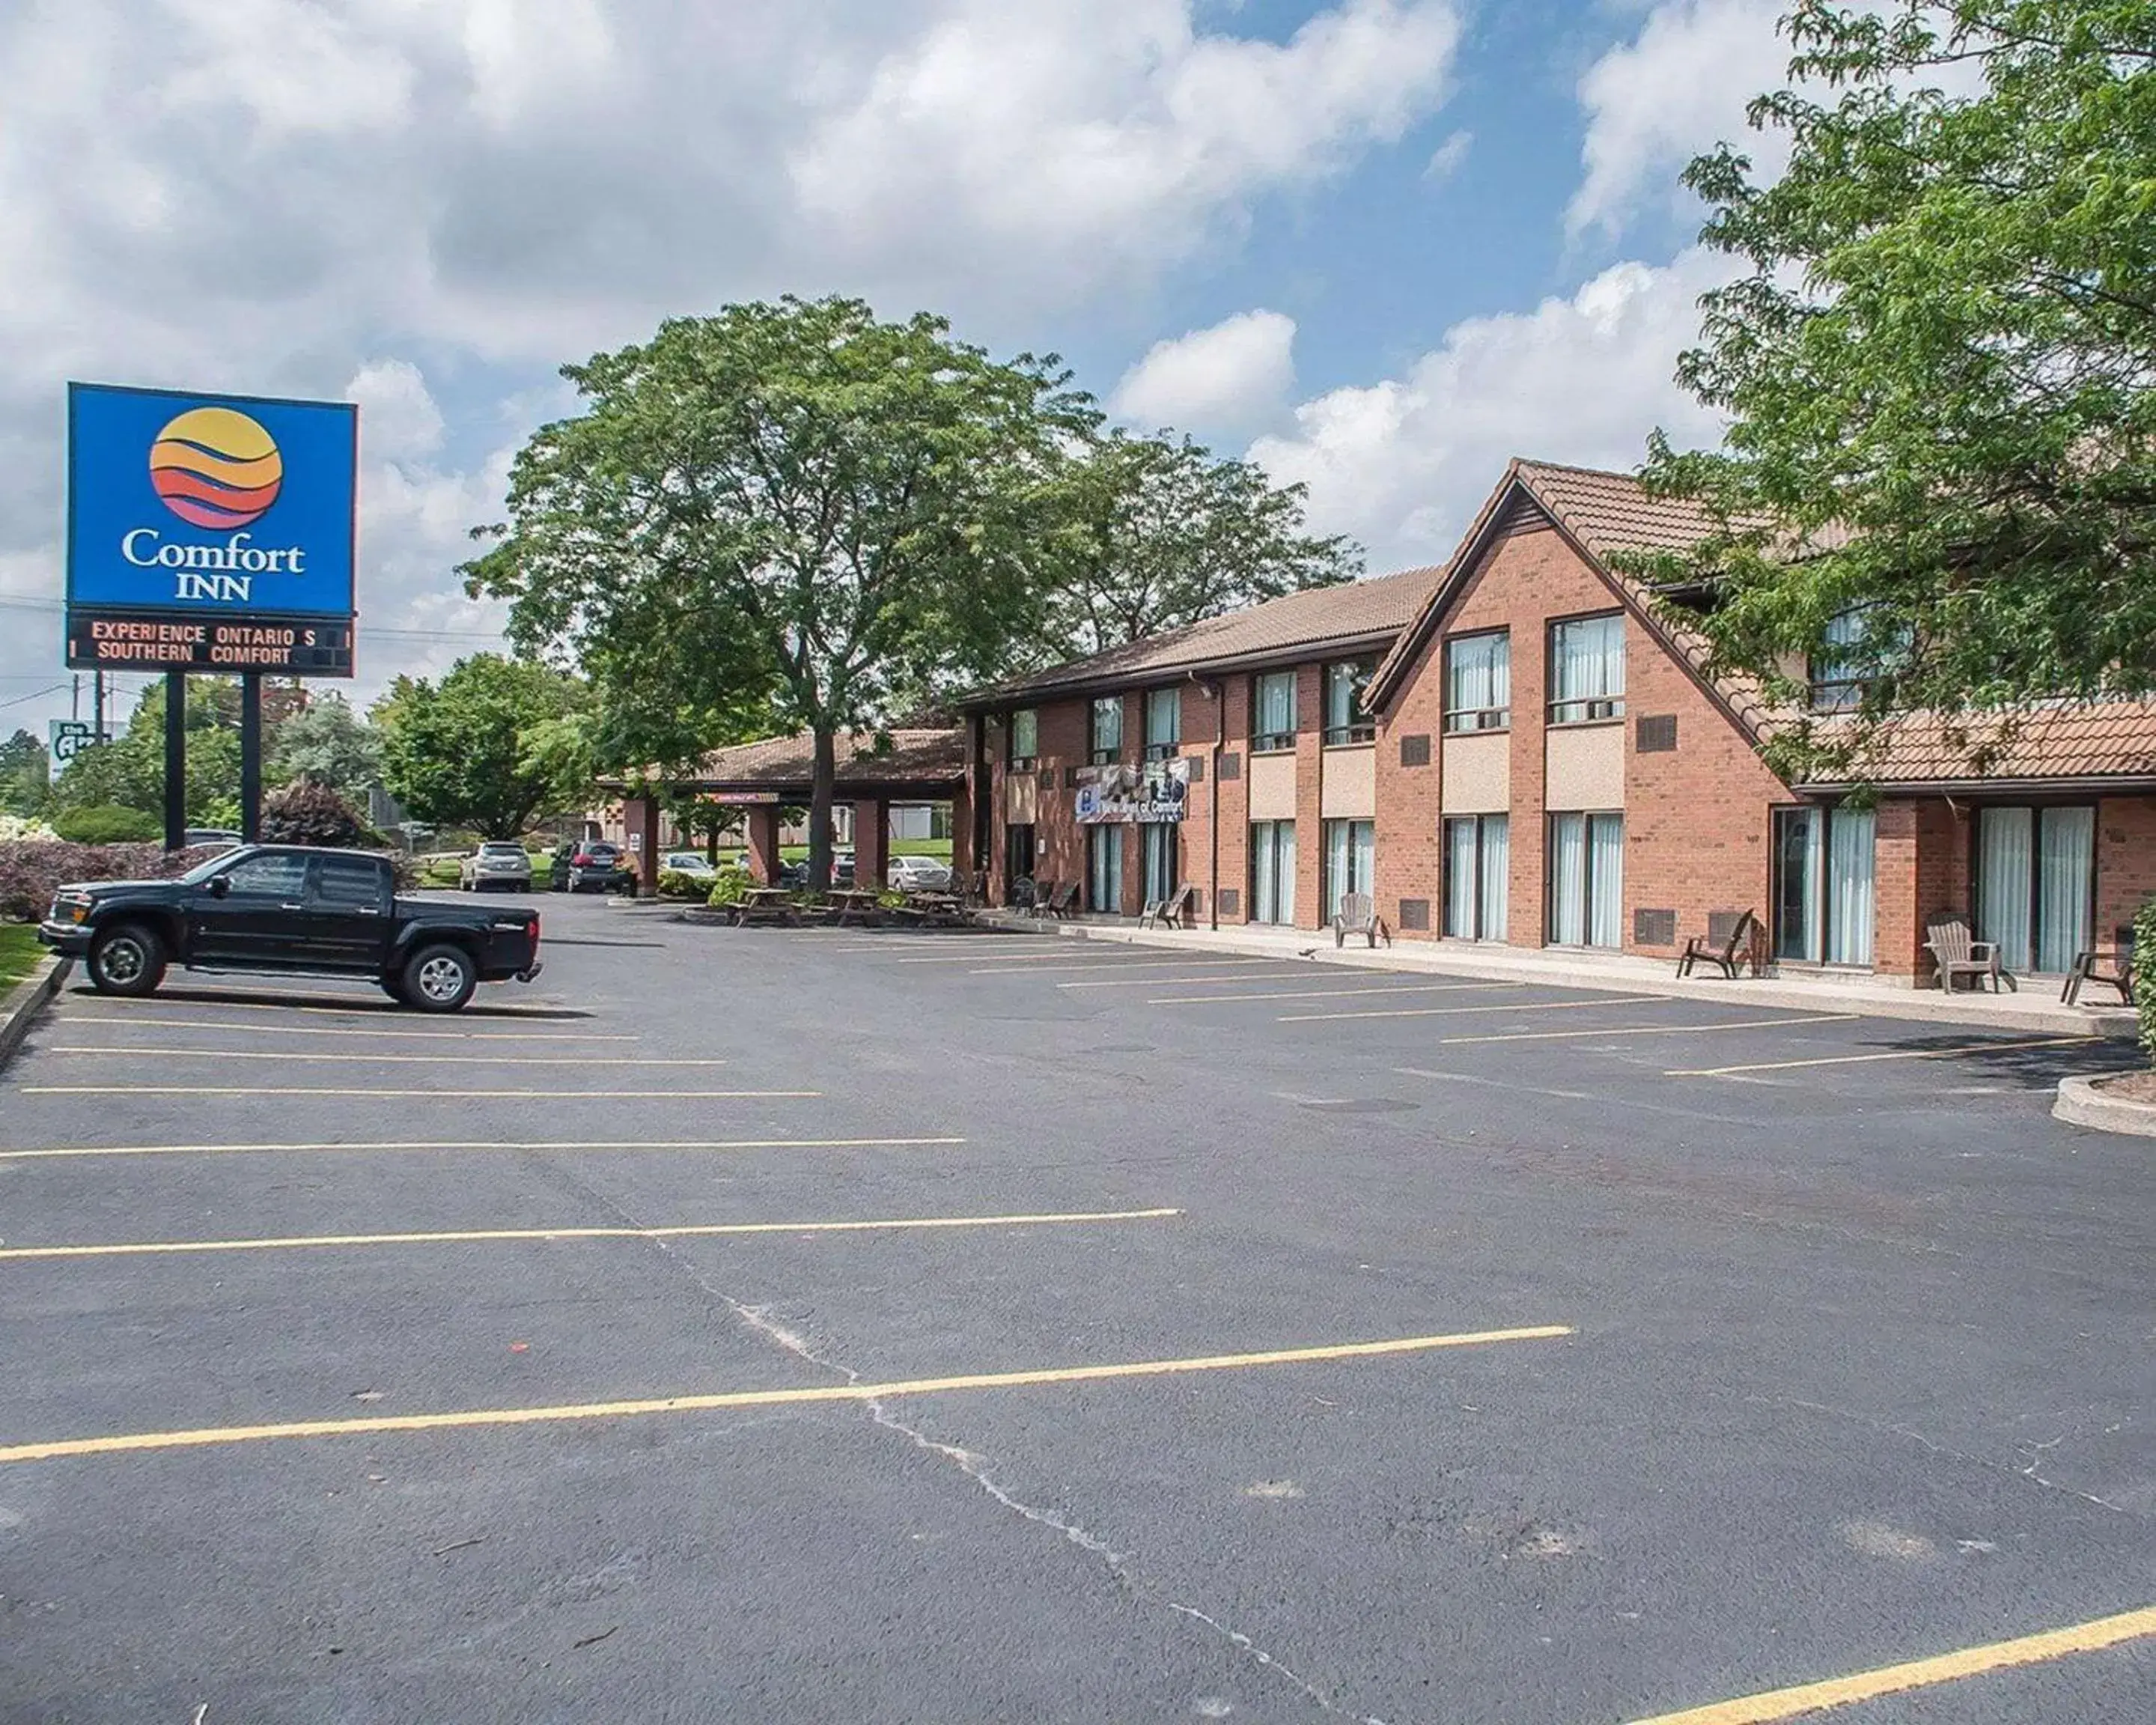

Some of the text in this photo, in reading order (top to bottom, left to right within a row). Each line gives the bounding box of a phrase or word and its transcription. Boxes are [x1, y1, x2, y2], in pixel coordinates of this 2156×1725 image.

[121, 529, 306, 574] Comfort
[174, 573, 252, 600] INN
[92, 621, 206, 643] EXPERIENCE
[216, 627, 295, 646] ONTARIO
[97, 641, 193, 662] SOUTHERN
[210, 645, 292, 665] COMFORT
